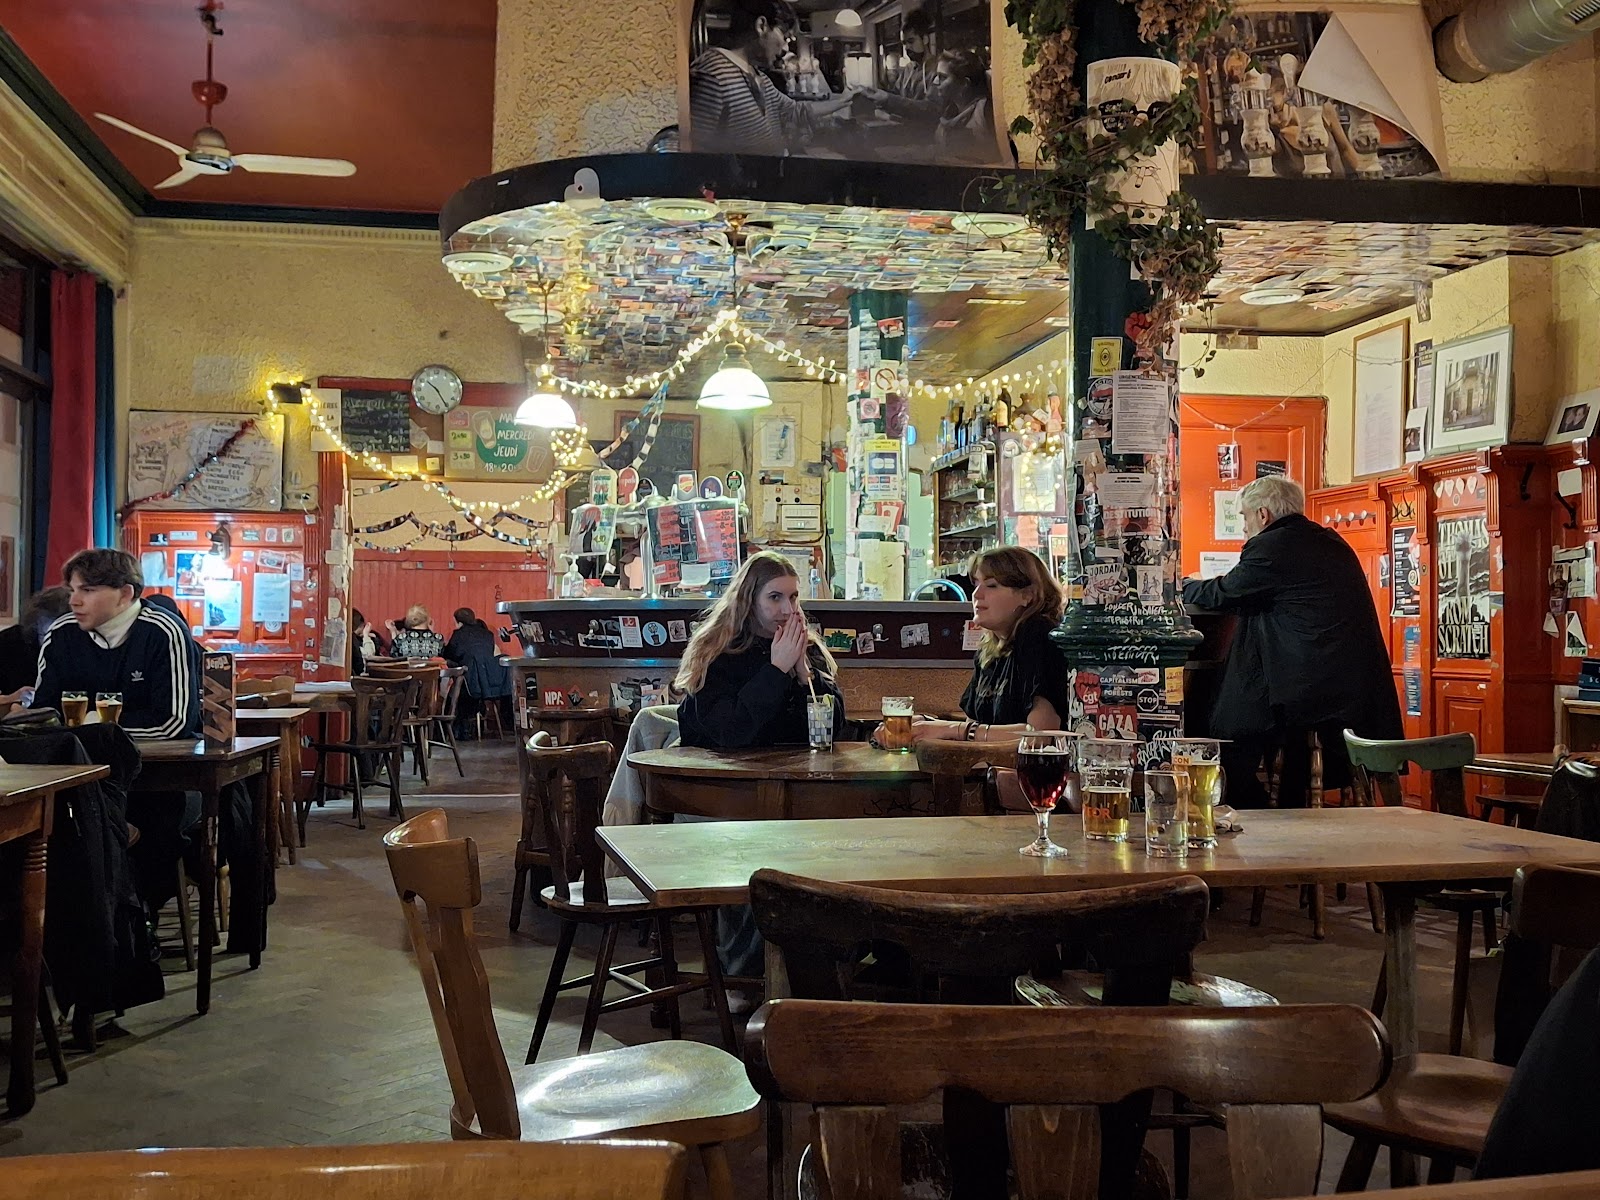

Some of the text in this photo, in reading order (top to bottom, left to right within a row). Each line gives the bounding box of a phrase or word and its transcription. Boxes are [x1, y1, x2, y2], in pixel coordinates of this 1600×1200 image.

[1437, 623, 1490, 655] SCRATCH
[544, 690, 565, 706] NPA
[1139, 696, 1157, 704] STOP
[1098, 713, 1134, 733] GAZA
